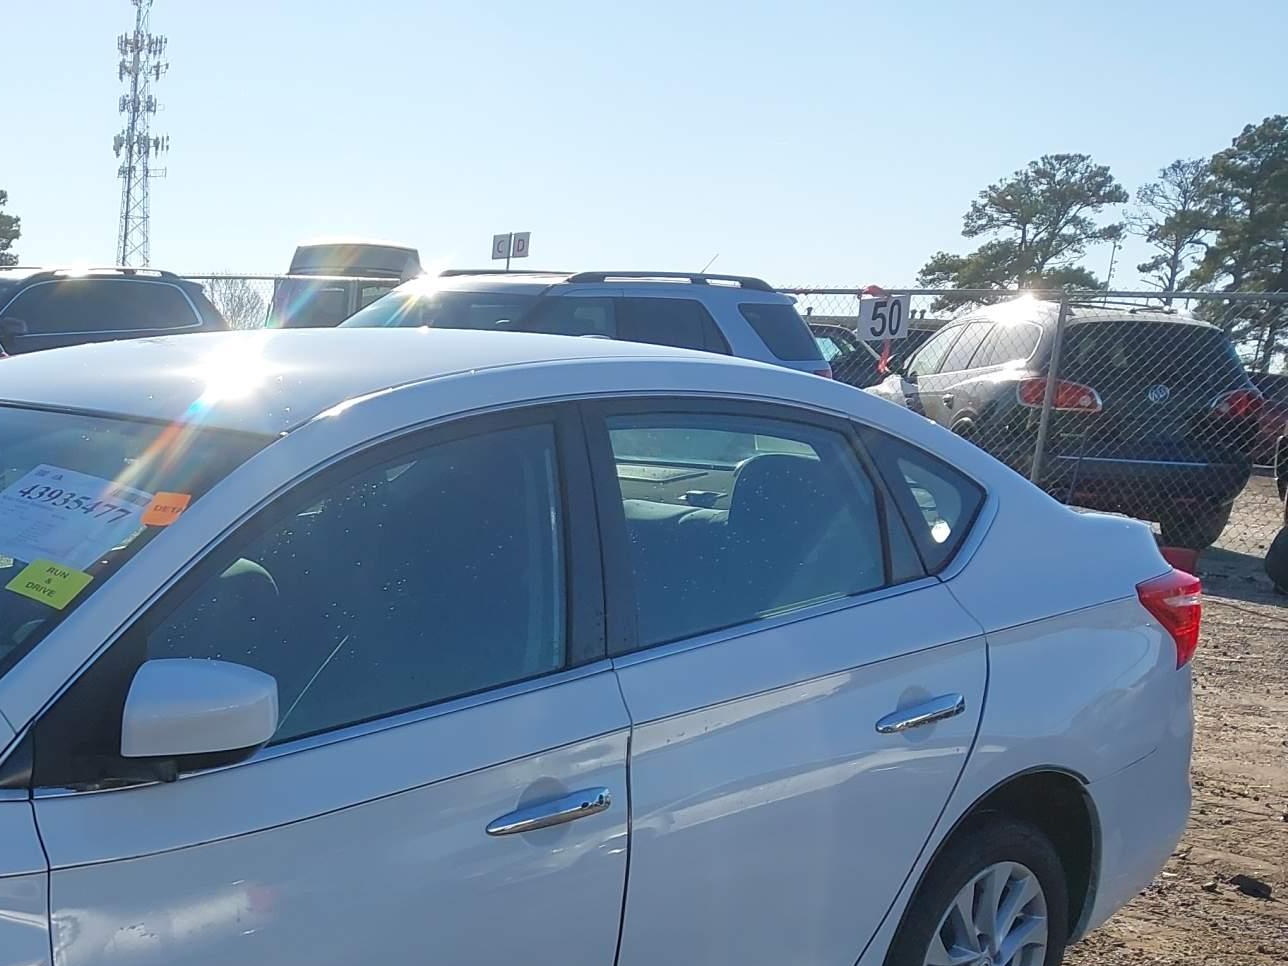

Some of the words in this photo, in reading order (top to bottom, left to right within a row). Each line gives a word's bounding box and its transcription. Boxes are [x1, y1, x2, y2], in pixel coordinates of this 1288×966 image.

[497, 239, 505, 254] C
[517, 239, 525, 252] D
[870, 299, 902, 337] 50
[19, 484, 132, 524] 43935477
[46, 566, 70, 579] RUN
[25, 581, 57, 598] DRIVE
